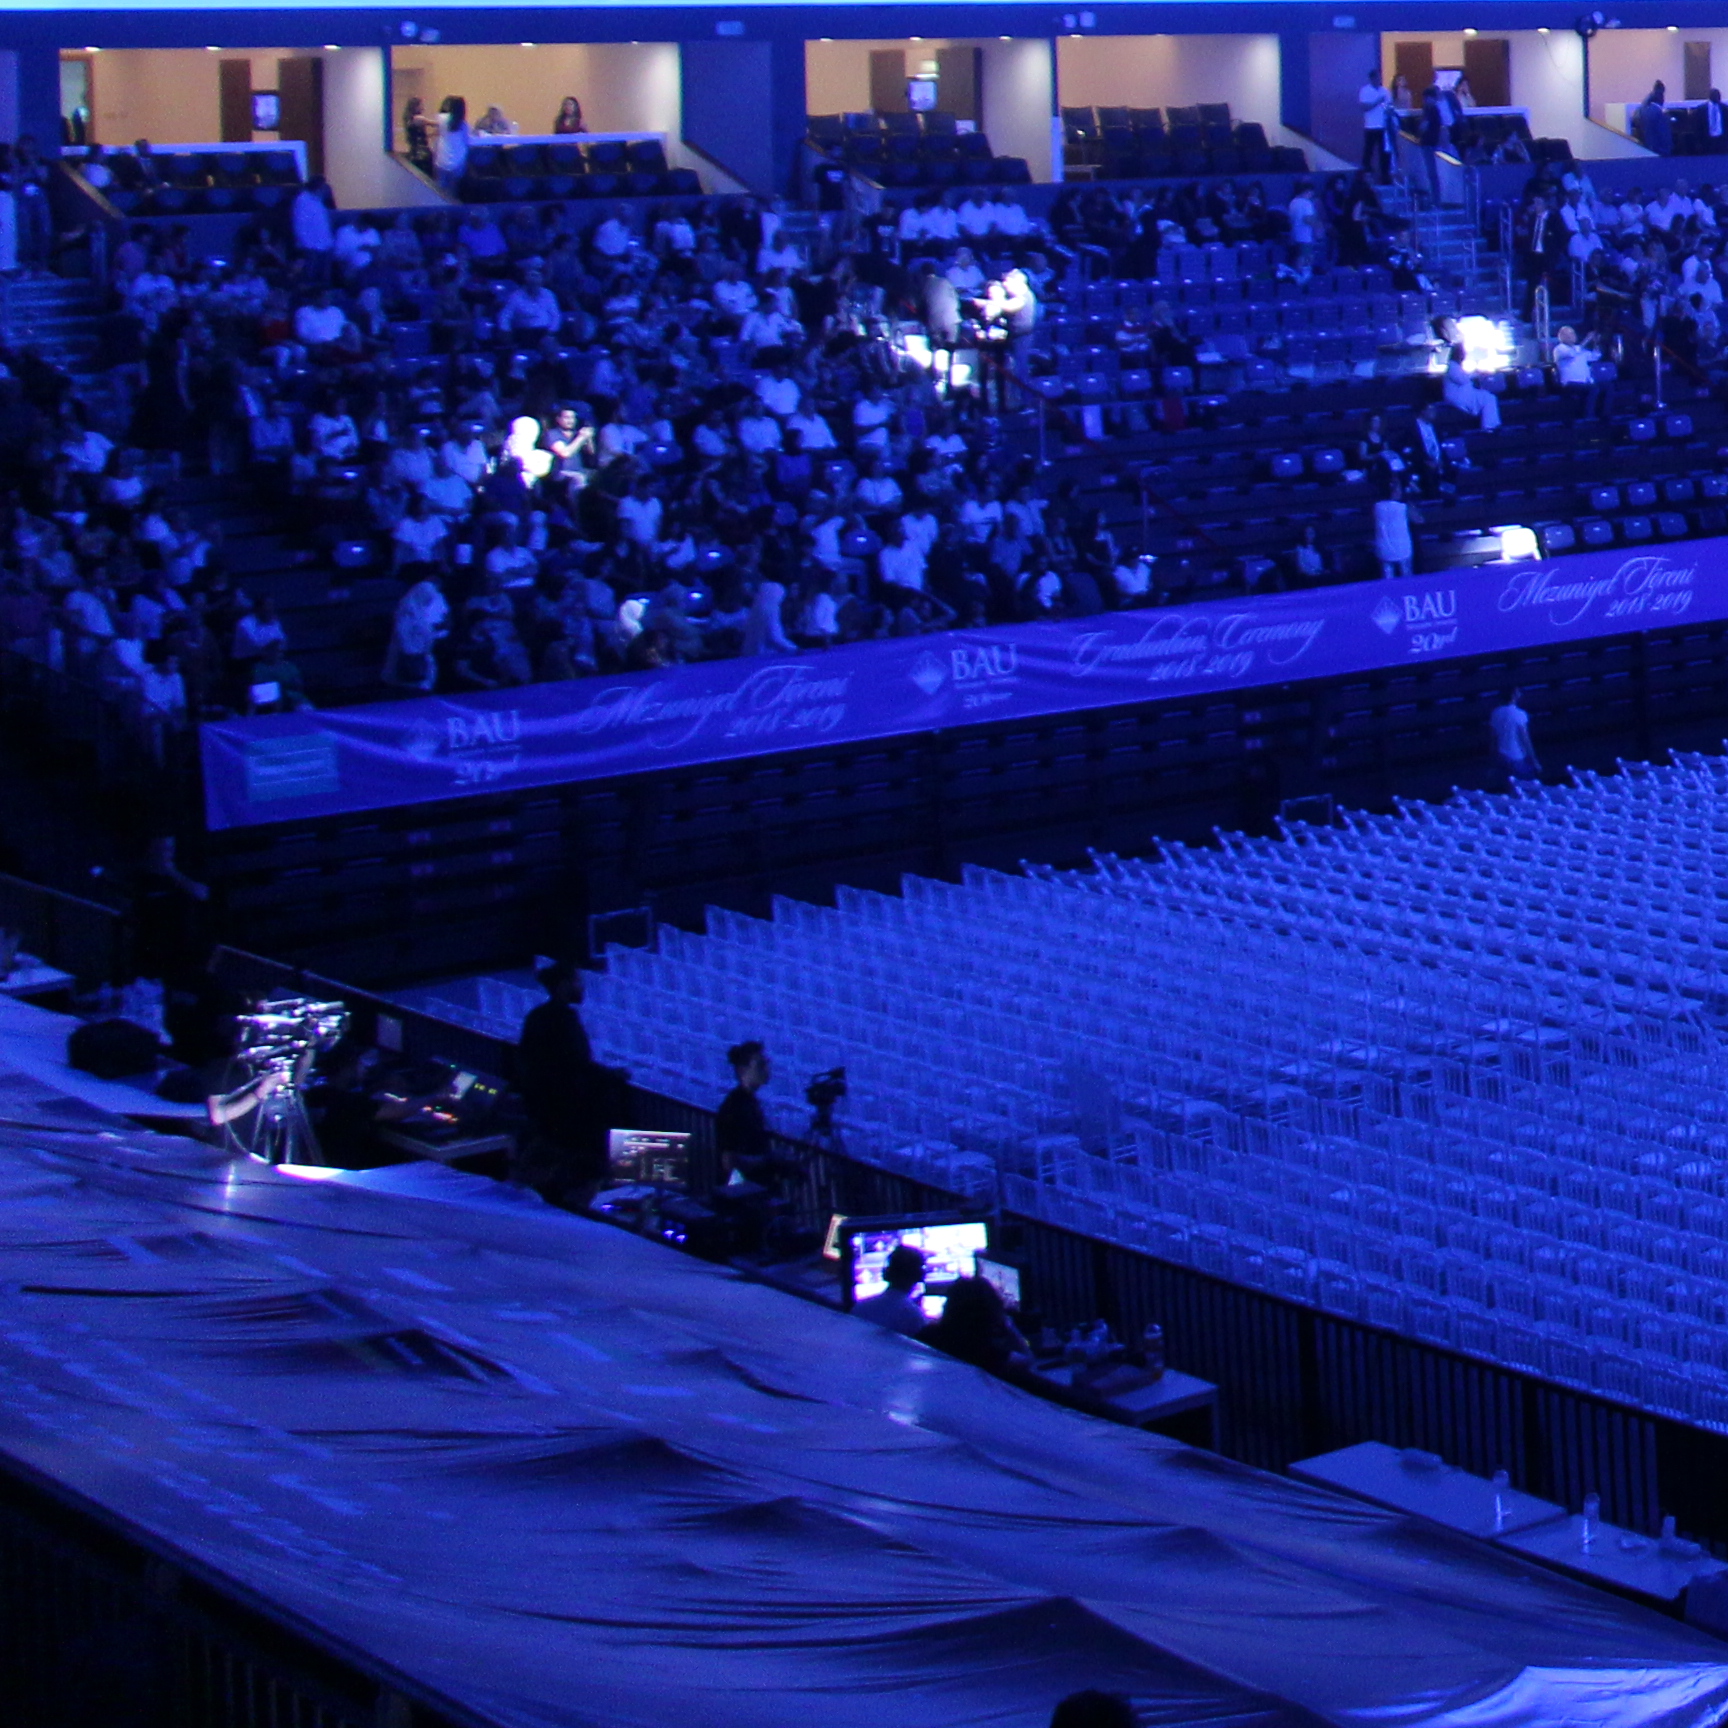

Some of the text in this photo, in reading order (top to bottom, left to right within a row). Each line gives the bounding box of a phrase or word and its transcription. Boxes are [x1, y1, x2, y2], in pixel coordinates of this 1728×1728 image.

[1403, 589, 1457, 622] BAU
[951, 643, 1018, 681] BAU
[446, 709, 521, 749] BAU
